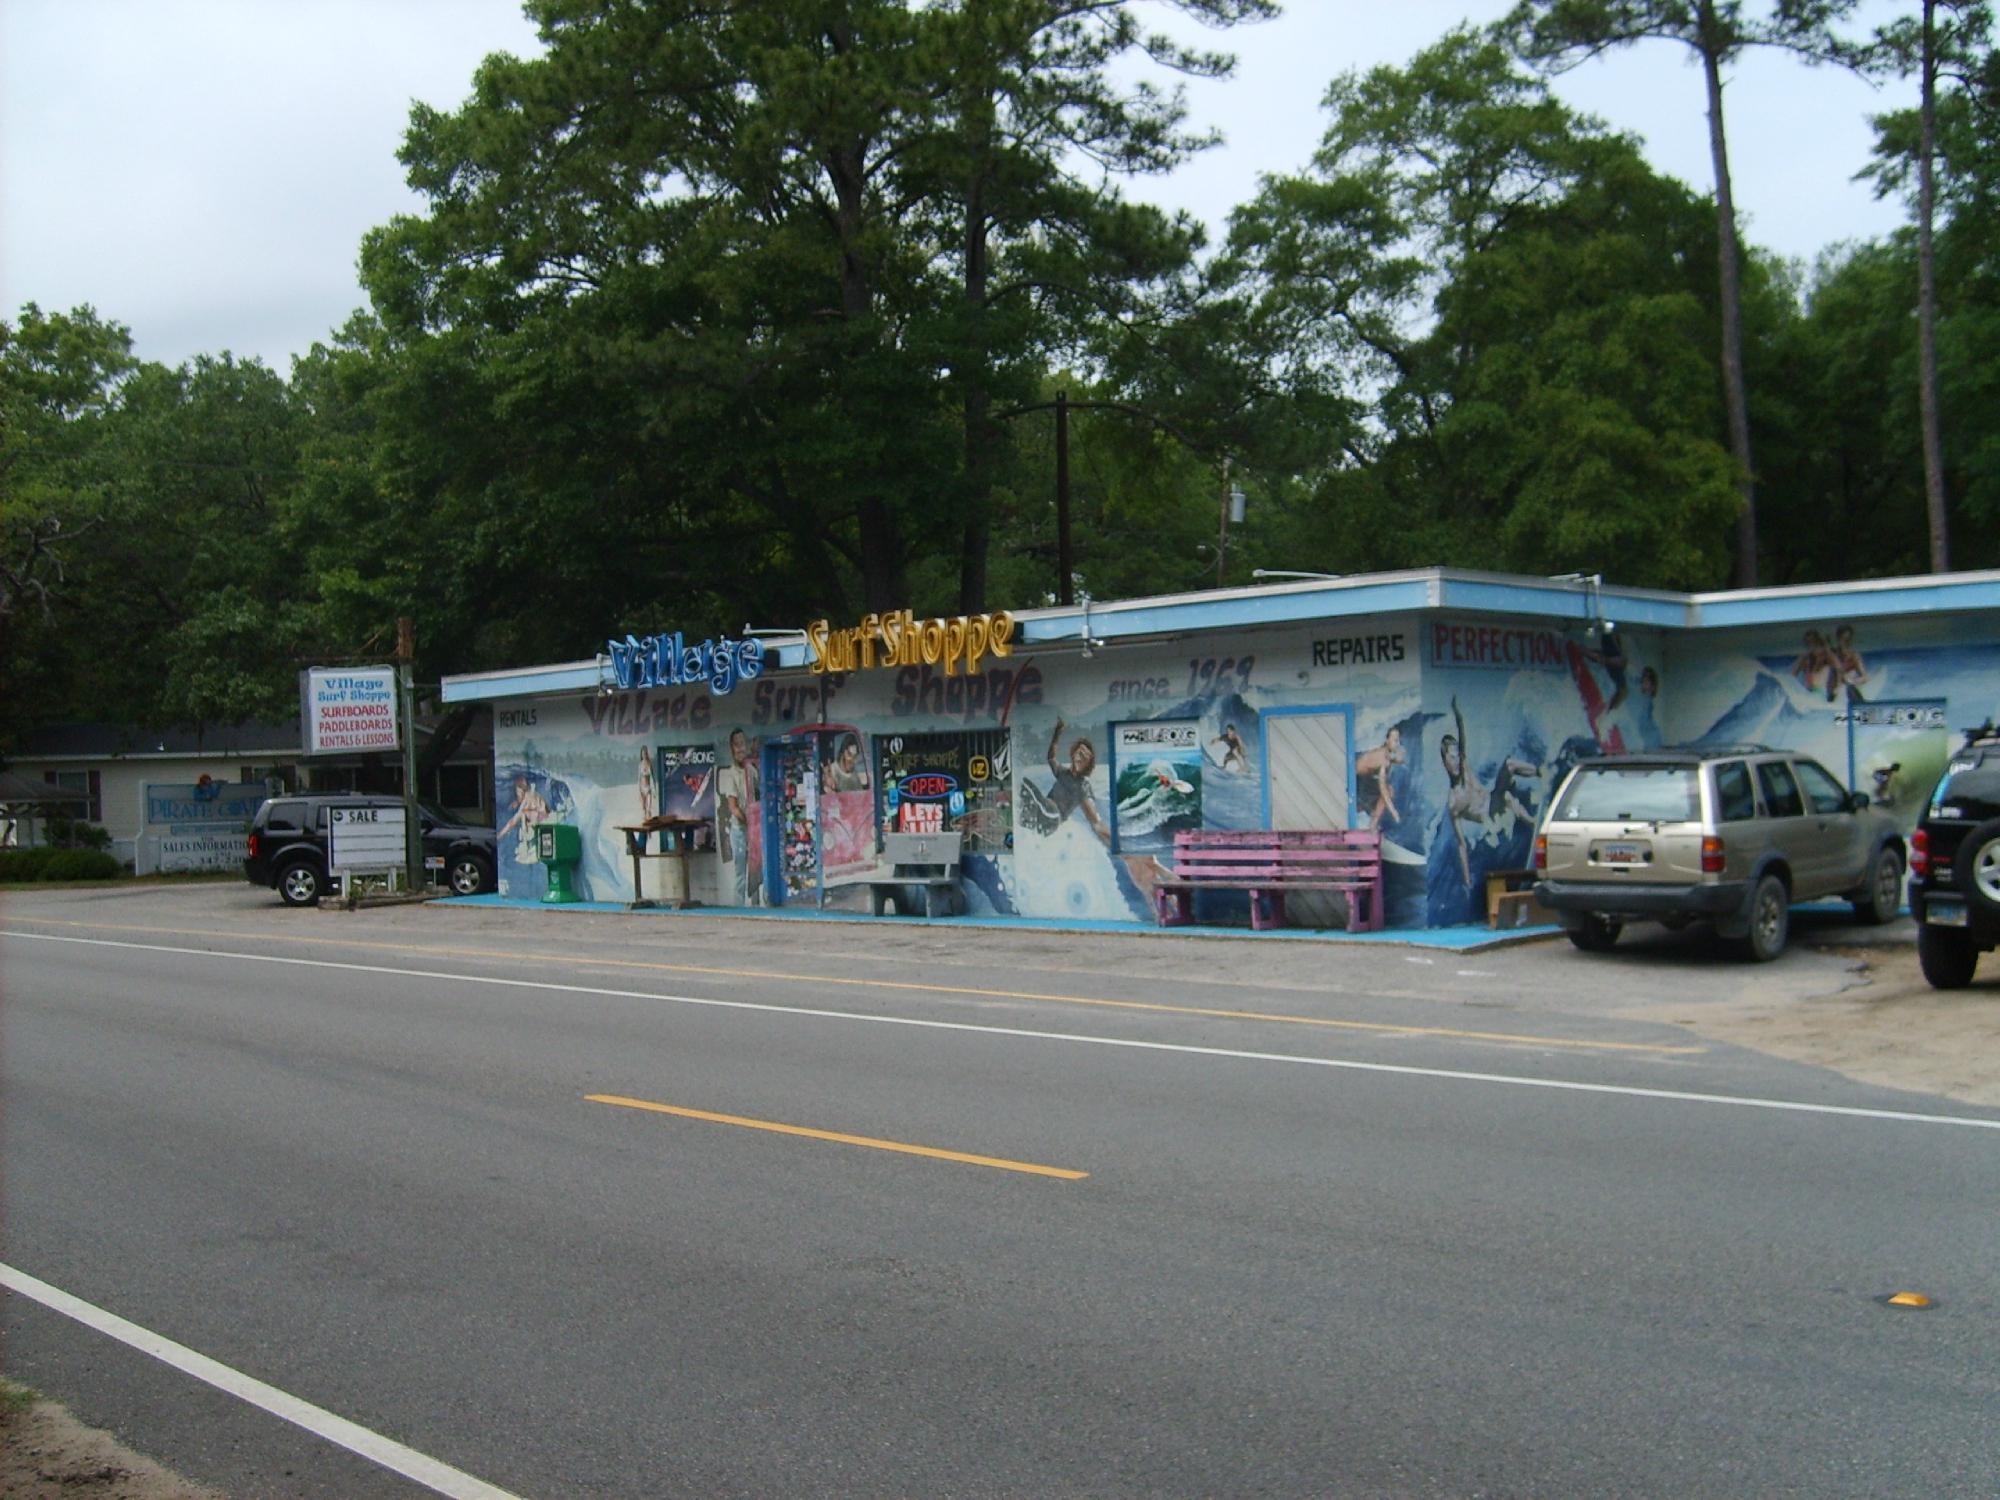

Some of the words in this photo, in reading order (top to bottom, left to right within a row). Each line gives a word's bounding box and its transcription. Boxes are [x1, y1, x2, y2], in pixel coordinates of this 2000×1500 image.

[1312, 634, 1405, 667] REPAIRS
[1434, 623, 1563, 664] PERFECTION
[609, 631, 764, 696] Village
[808, 613, 879, 675] Surf
[880, 609, 1014, 677] Shoppe
[325, 678, 384, 690] Village
[1108, 677, 1170, 702] since
[1187, 655, 1255, 697] 1969
[318, 690, 346, 702] Surf
[350, 689, 391, 702] Shoppe
[752, 678, 845, 725] Surf
[892, 665, 1043, 721] Shoppe
[321, 704, 389, 718] SURFBOARDS
[499, 708, 537, 729] RENTALS
[319, 719, 393, 733] PADDLEBOARDS
[319, 735, 354, 747] RENTALS
[355, 736, 361, 746] &
[362, 733, 394, 745] LESSONS
[909, 777, 946, 795] OPEN
[349, 810, 378, 823] SALE
[163, 841, 191, 852] SALES
